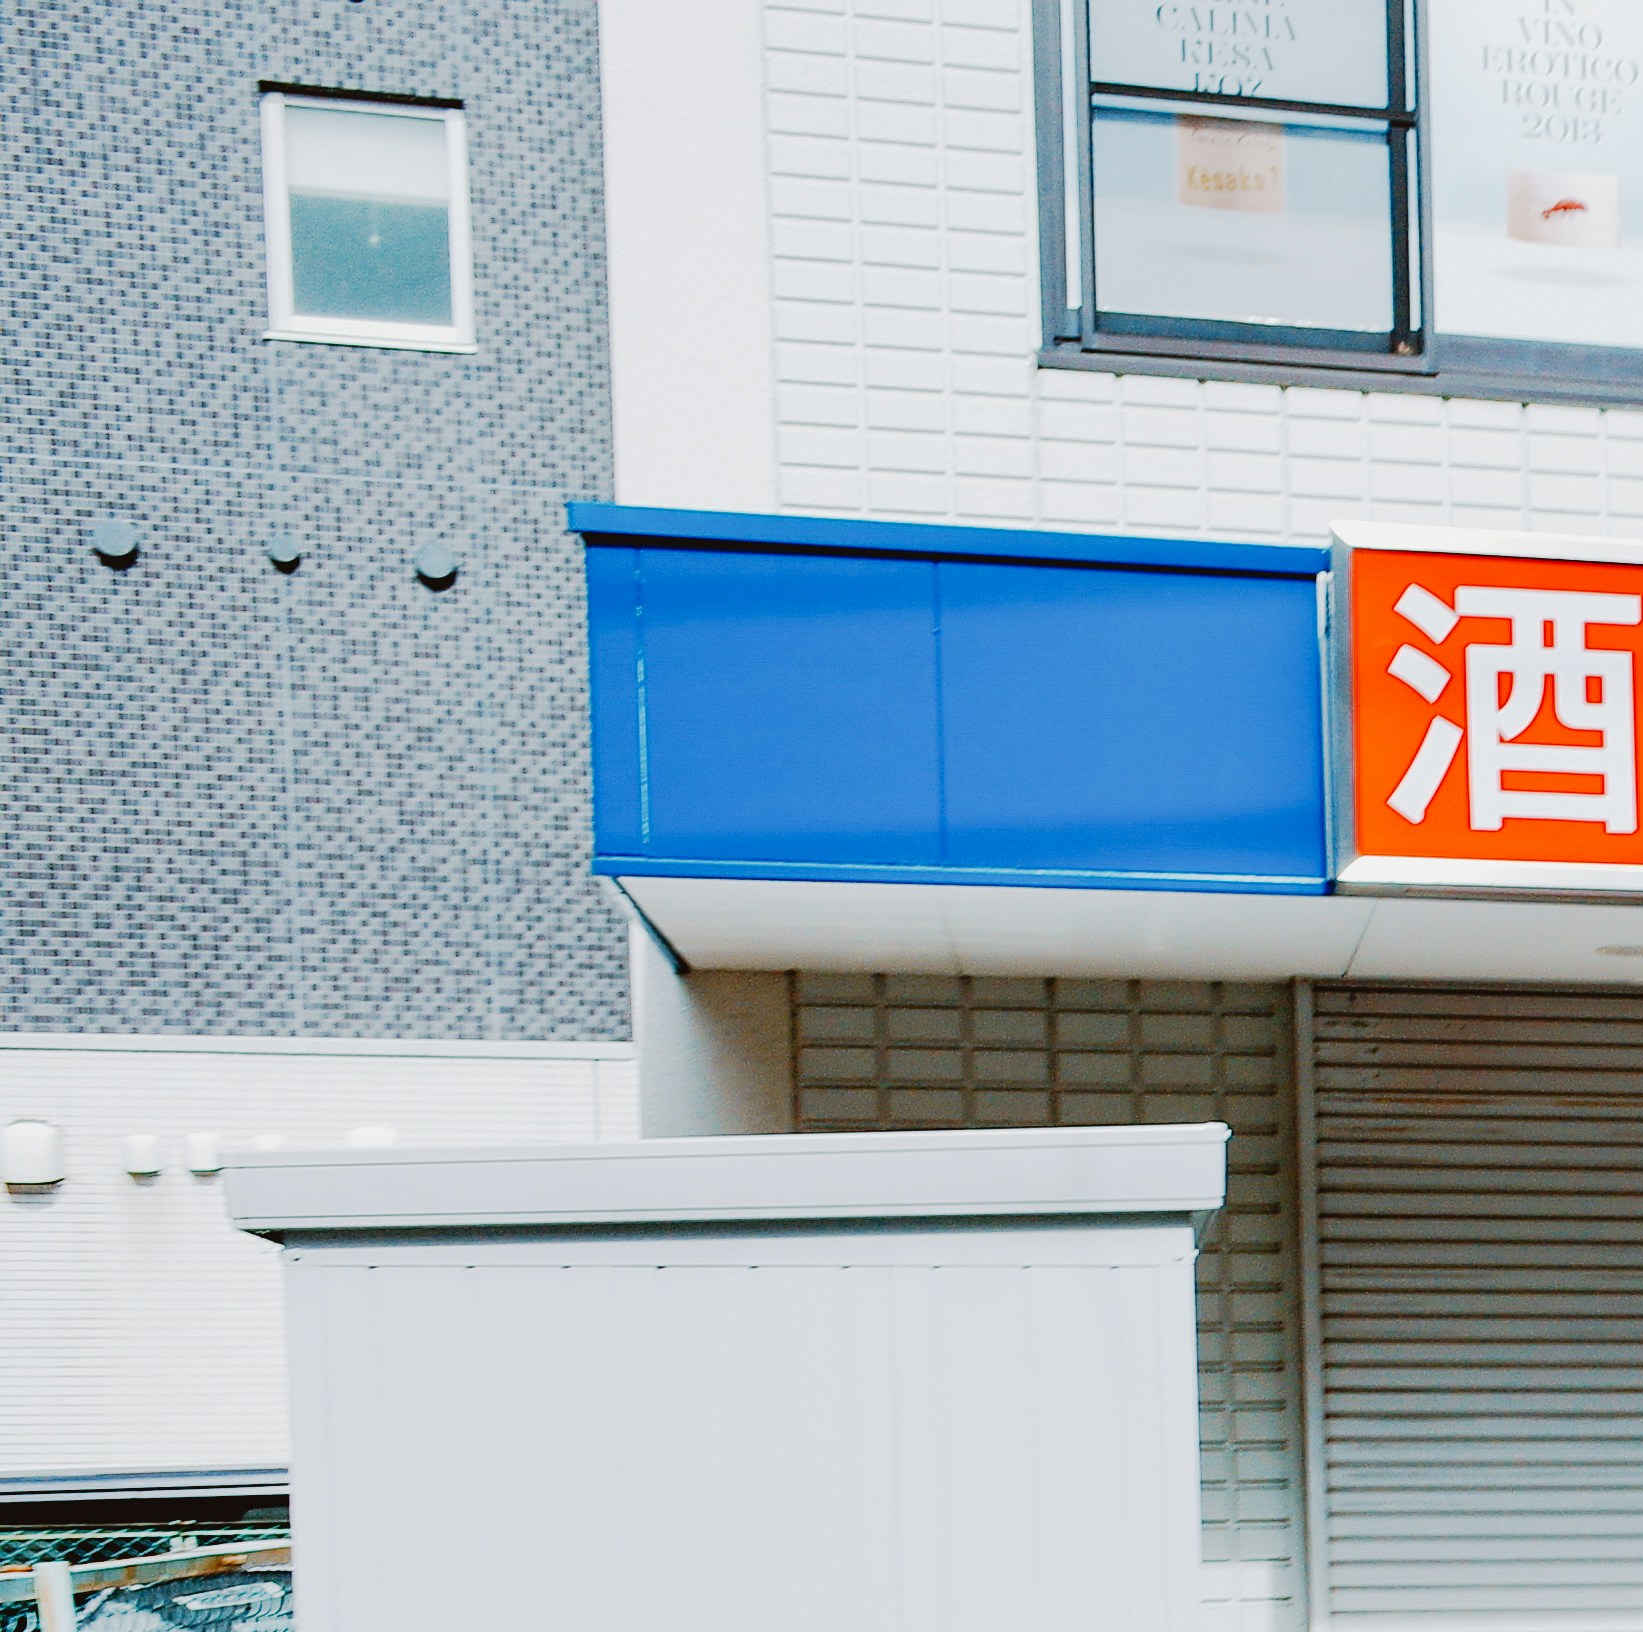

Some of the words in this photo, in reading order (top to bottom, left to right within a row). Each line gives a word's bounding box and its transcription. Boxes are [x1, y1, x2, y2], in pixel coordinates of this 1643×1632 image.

[1156, 4, 1295, 40] CALIMA
[1518, 17, 1602, 49] VINO
[1181, 39, 1274, 70] KESA
[1482, 44, 1640, 85] EROTICO
[1501, 79, 1623, 115] ROUGE
[1386, 582, 1643, 835] 酒
